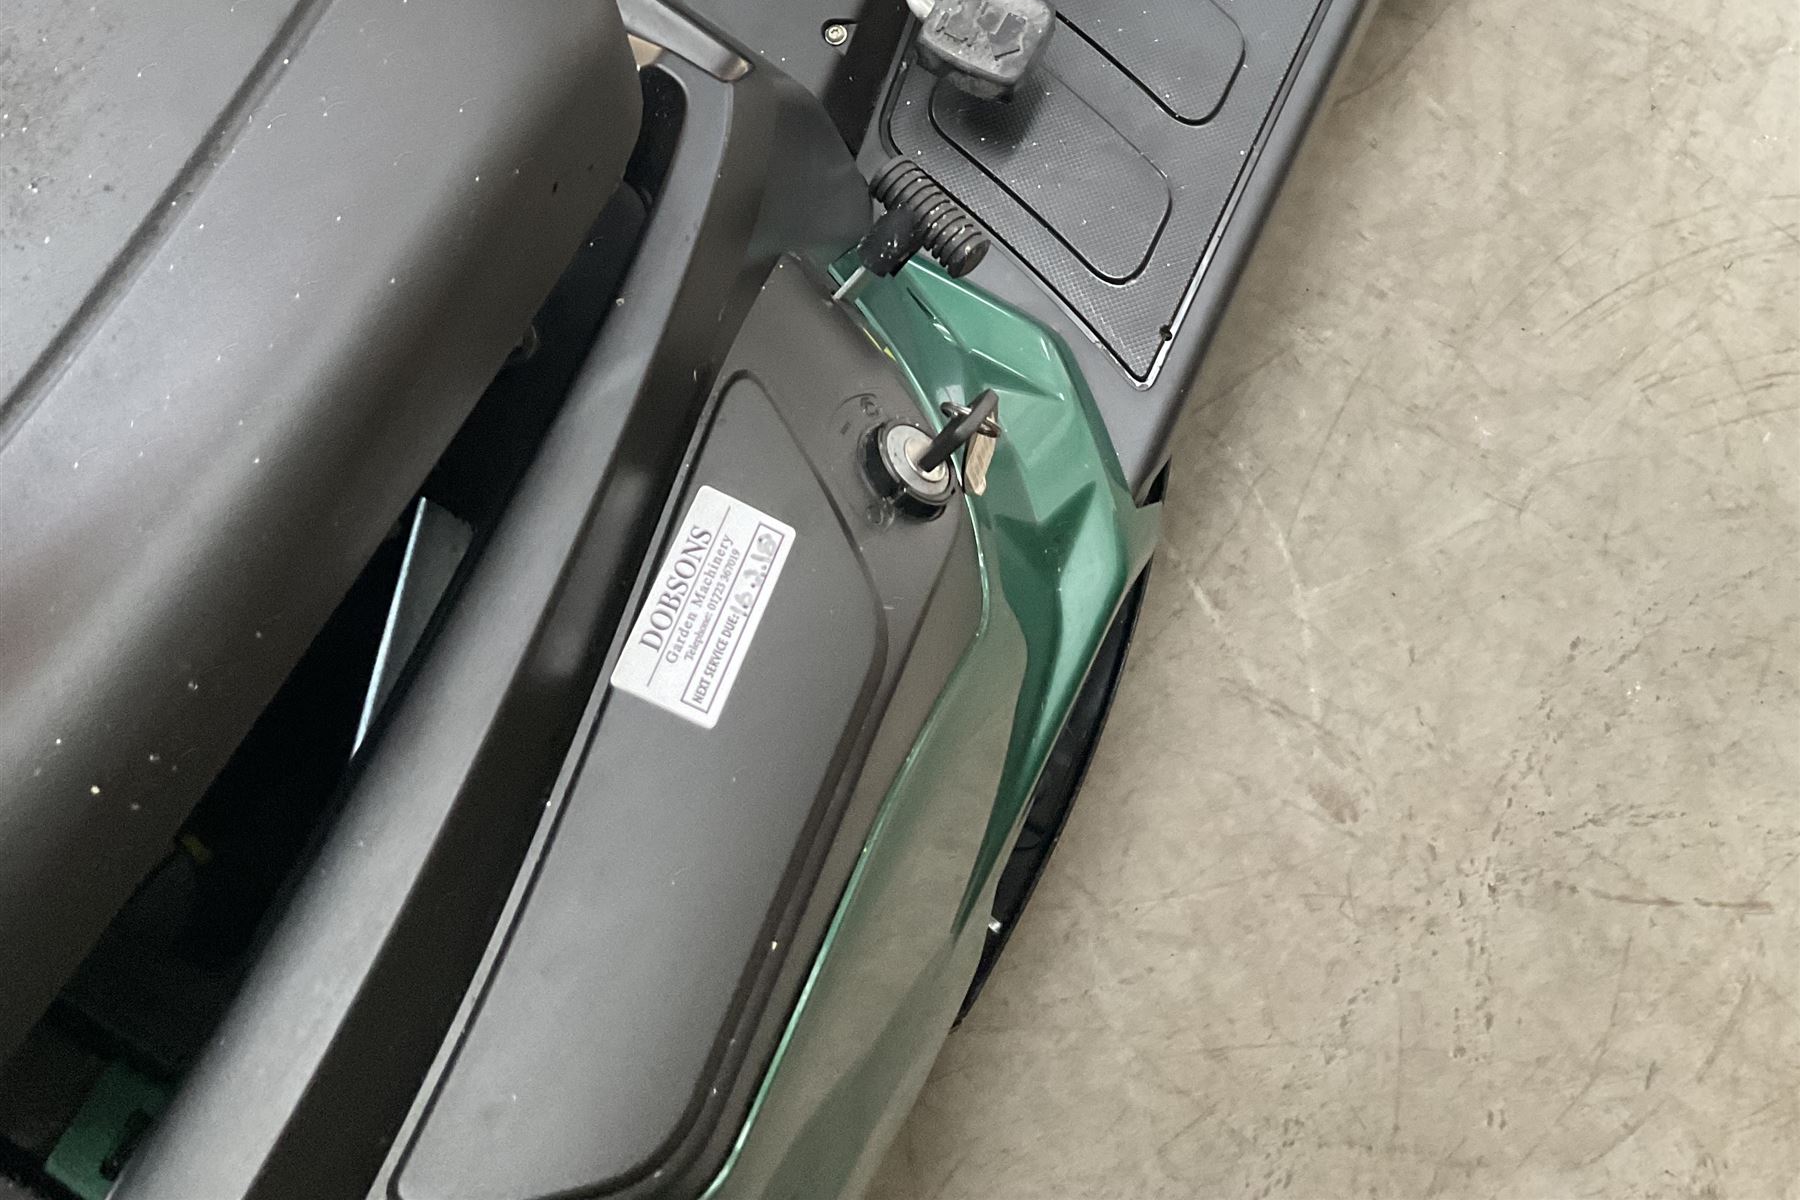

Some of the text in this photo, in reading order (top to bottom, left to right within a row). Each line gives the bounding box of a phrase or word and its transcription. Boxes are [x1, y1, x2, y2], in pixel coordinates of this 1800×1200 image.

[638, 525, 712, 652] DOBSONS
[665, 533, 734, 664] Garden Machinery
[683, 611, 713, 661] Telephone:
[707, 582, 726, 611] 01723
[692, 614, 740, 704] NEXT SERVICE DUE:
